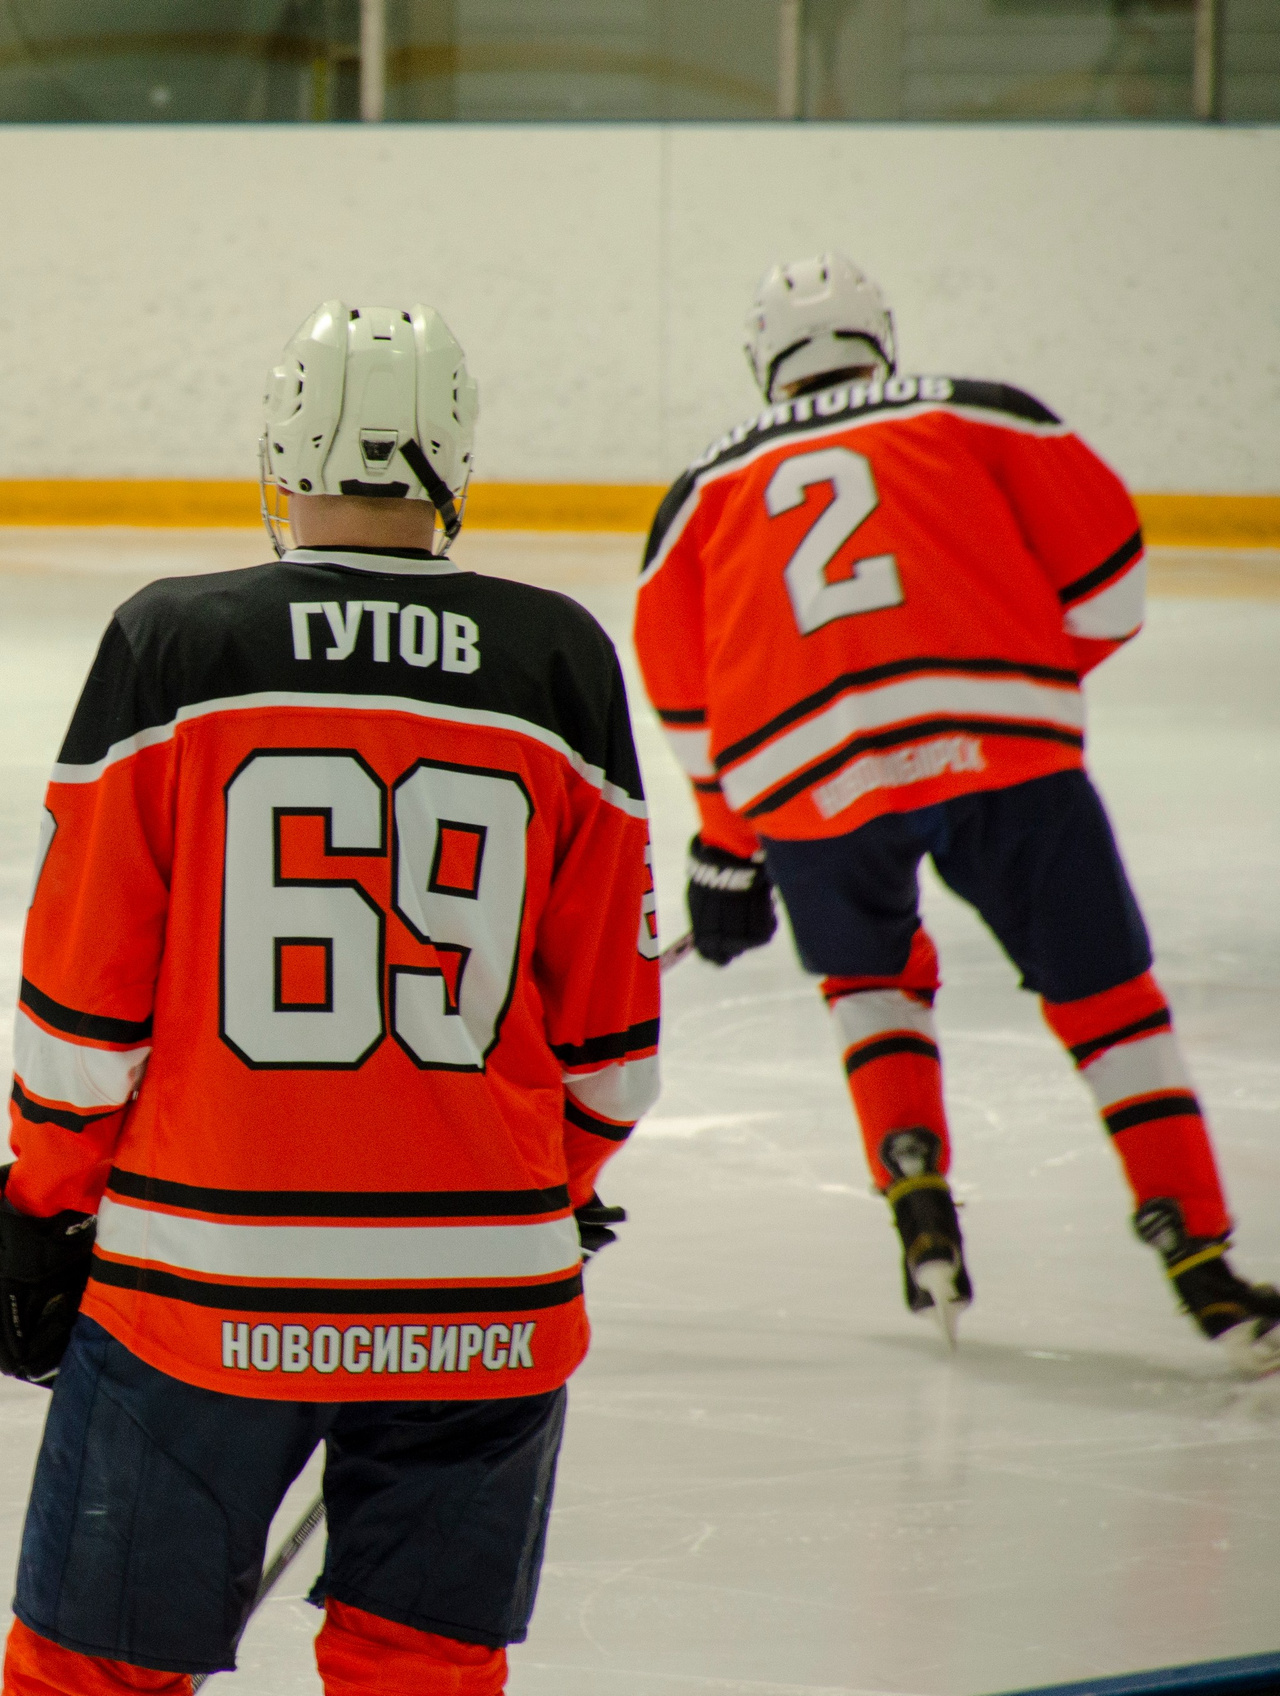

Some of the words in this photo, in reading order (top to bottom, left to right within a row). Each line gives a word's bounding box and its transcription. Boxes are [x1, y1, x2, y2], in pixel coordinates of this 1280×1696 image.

[763, 445, 907, 638] 2
[288, 600, 482, 675] ГУТОВ
[218, 746, 536, 1076] 69
[221, 1319, 538, 1374] НОВОСИБИРСК
